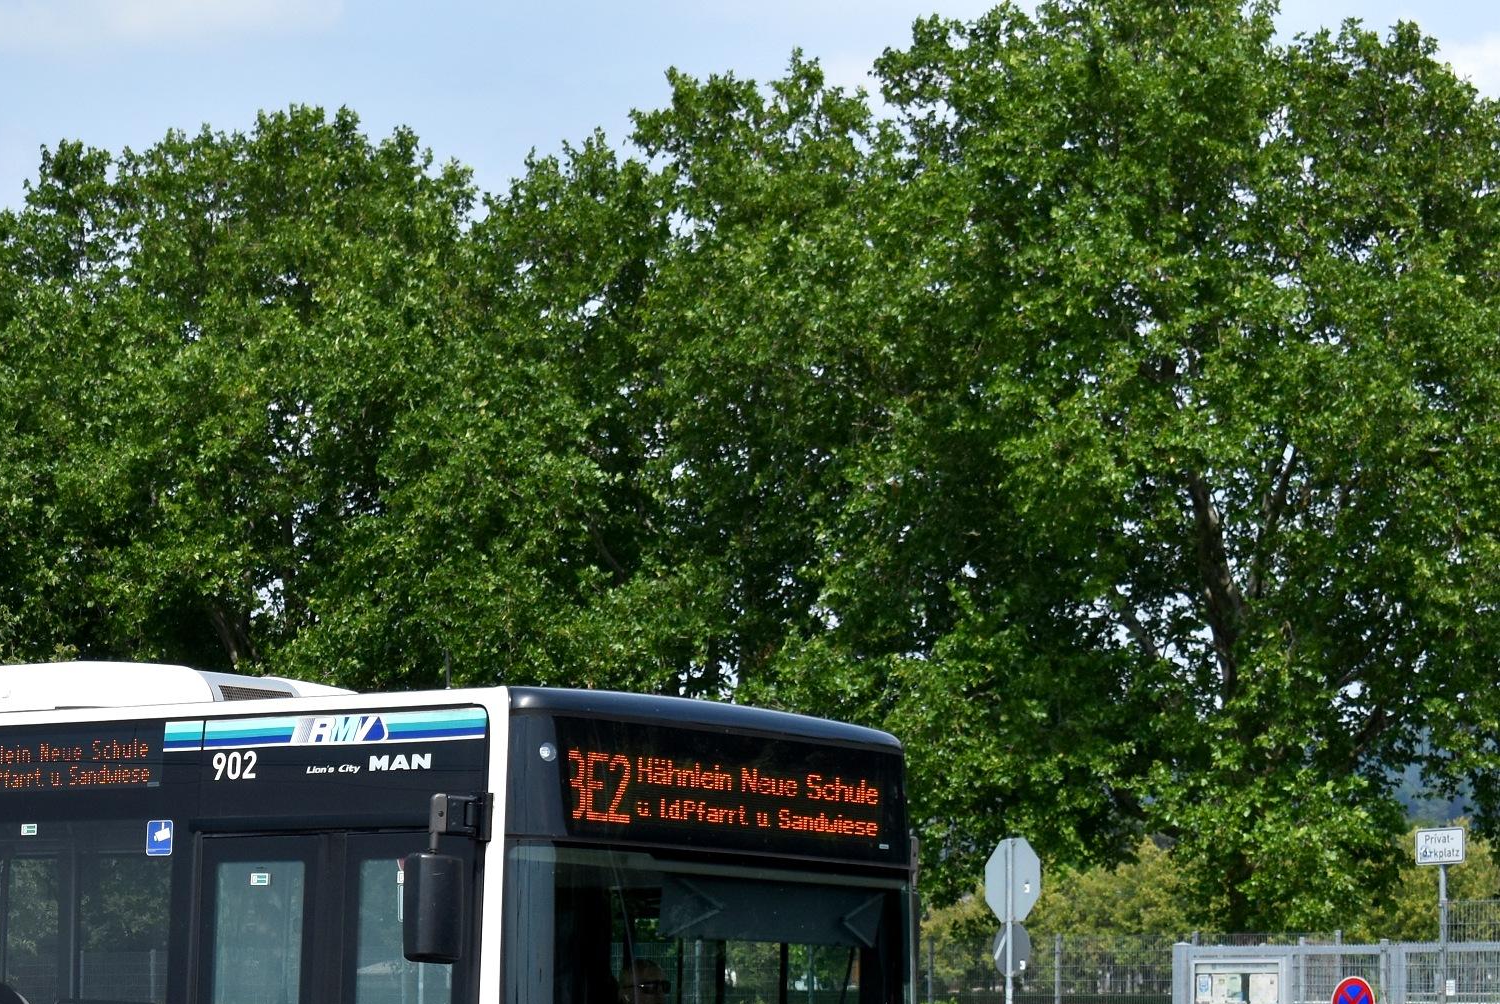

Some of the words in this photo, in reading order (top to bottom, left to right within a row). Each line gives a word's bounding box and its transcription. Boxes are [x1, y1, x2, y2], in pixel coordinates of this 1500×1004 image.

[306, 715, 378, 743] RMV
[40, 743, 82, 762] Neue
[92, 738, 149, 760] Schule
[69, 764, 150, 786] Sandwiese
[212, 750, 257, 781] 902
[306, 765, 334, 774] Lion's
[338, 764, 361, 774] City
[369, 753, 432, 772] MAN
[636, 756, 732, 792] Hähnlein
[741, 767, 798, 797] Neue
[806, 774, 878, 805] Schule
[778, 809, 878, 837] Sandwiese
[1424, 834, 1454, 844] Privat-
